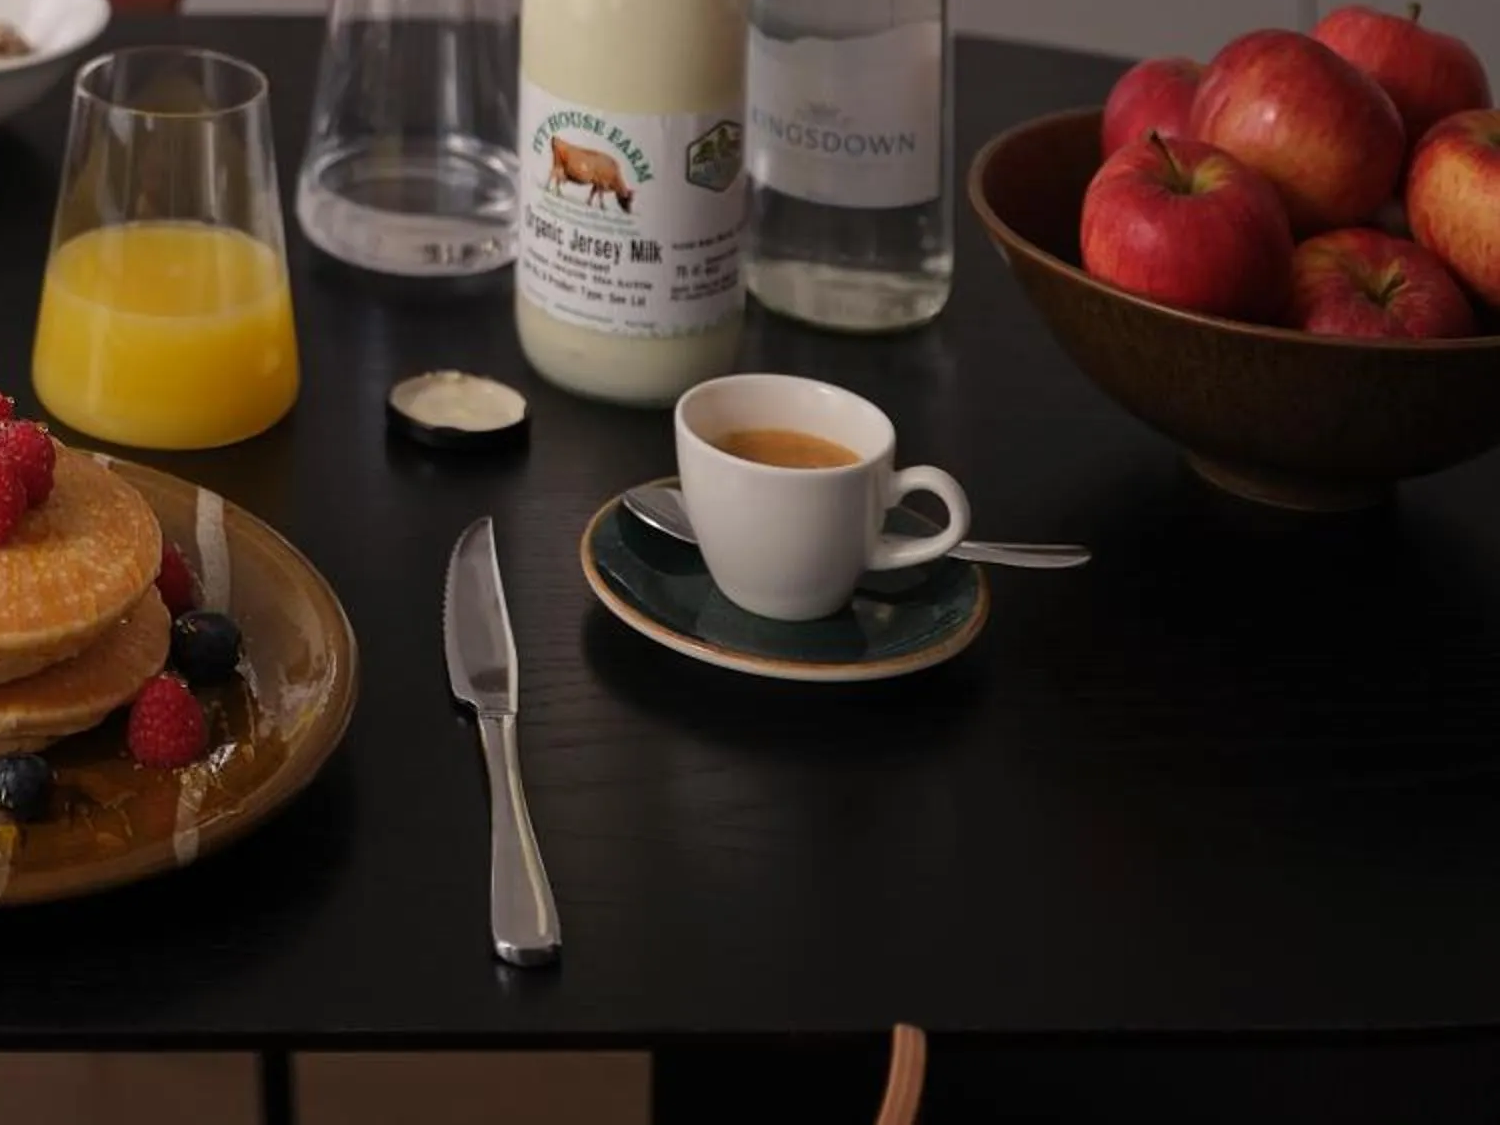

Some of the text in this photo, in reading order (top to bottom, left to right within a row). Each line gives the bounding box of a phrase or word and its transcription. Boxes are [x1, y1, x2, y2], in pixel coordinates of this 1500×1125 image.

[547, 112, 606, 135] HOUSE
[607, 126, 653, 183] FARM
[525, 204, 564, 245] Organic
[570, 228, 623, 265] Jersey
[630, 239, 662, 264] Milk
